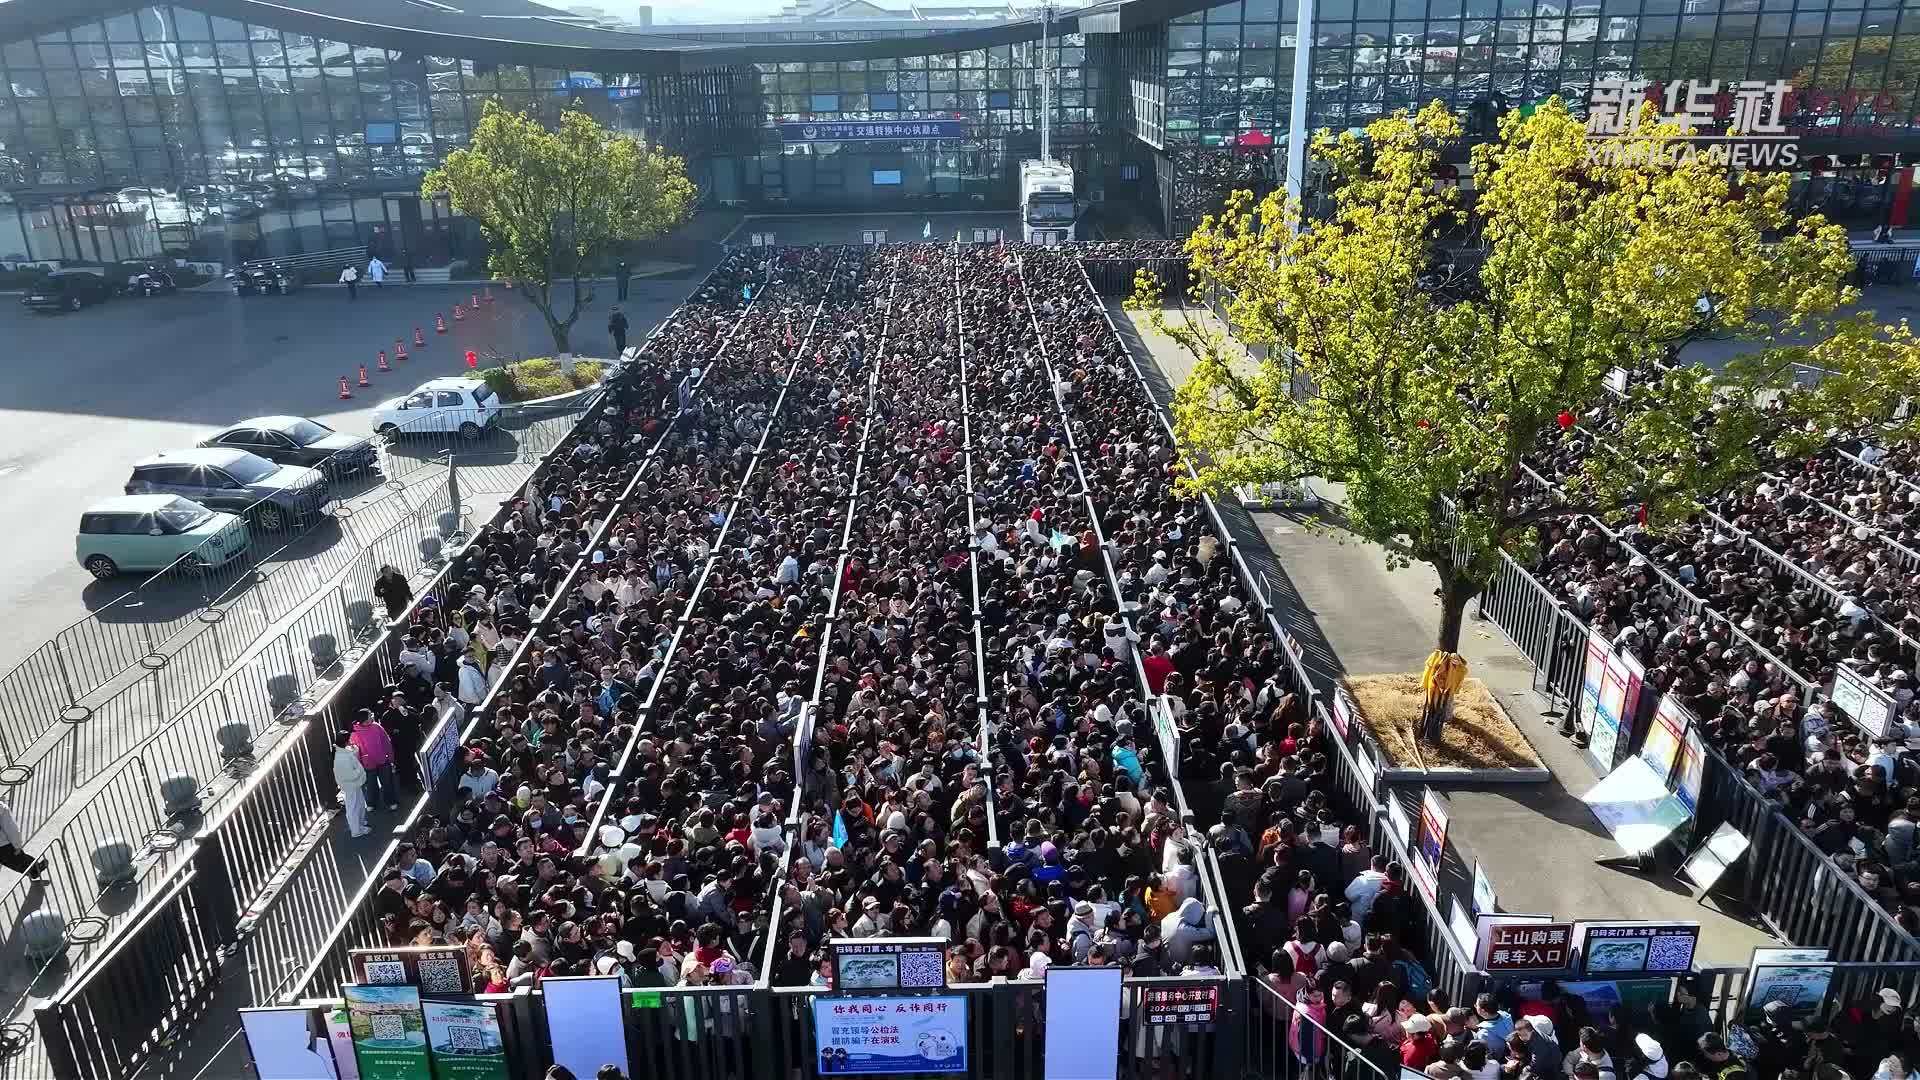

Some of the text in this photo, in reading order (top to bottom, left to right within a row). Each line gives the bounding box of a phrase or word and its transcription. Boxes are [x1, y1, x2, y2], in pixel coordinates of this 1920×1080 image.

[856, 124, 940, 136] 交通转换中心执勤点
[1496, 930, 1565, 945] 上山购票
[836, 945, 903, 953] 扫码买门票、车票
[1492, 950, 1561, 964] 乘车入口
[1147, 989, 1216, 1002] 游客服务中心开放时间
[833, 1003, 948, 1014] 你我同心 反诈同行
[832, 1025, 899, 1035] 冒充领导公检法
[832, 1036, 900, 1045] 提防骗子在演戏
